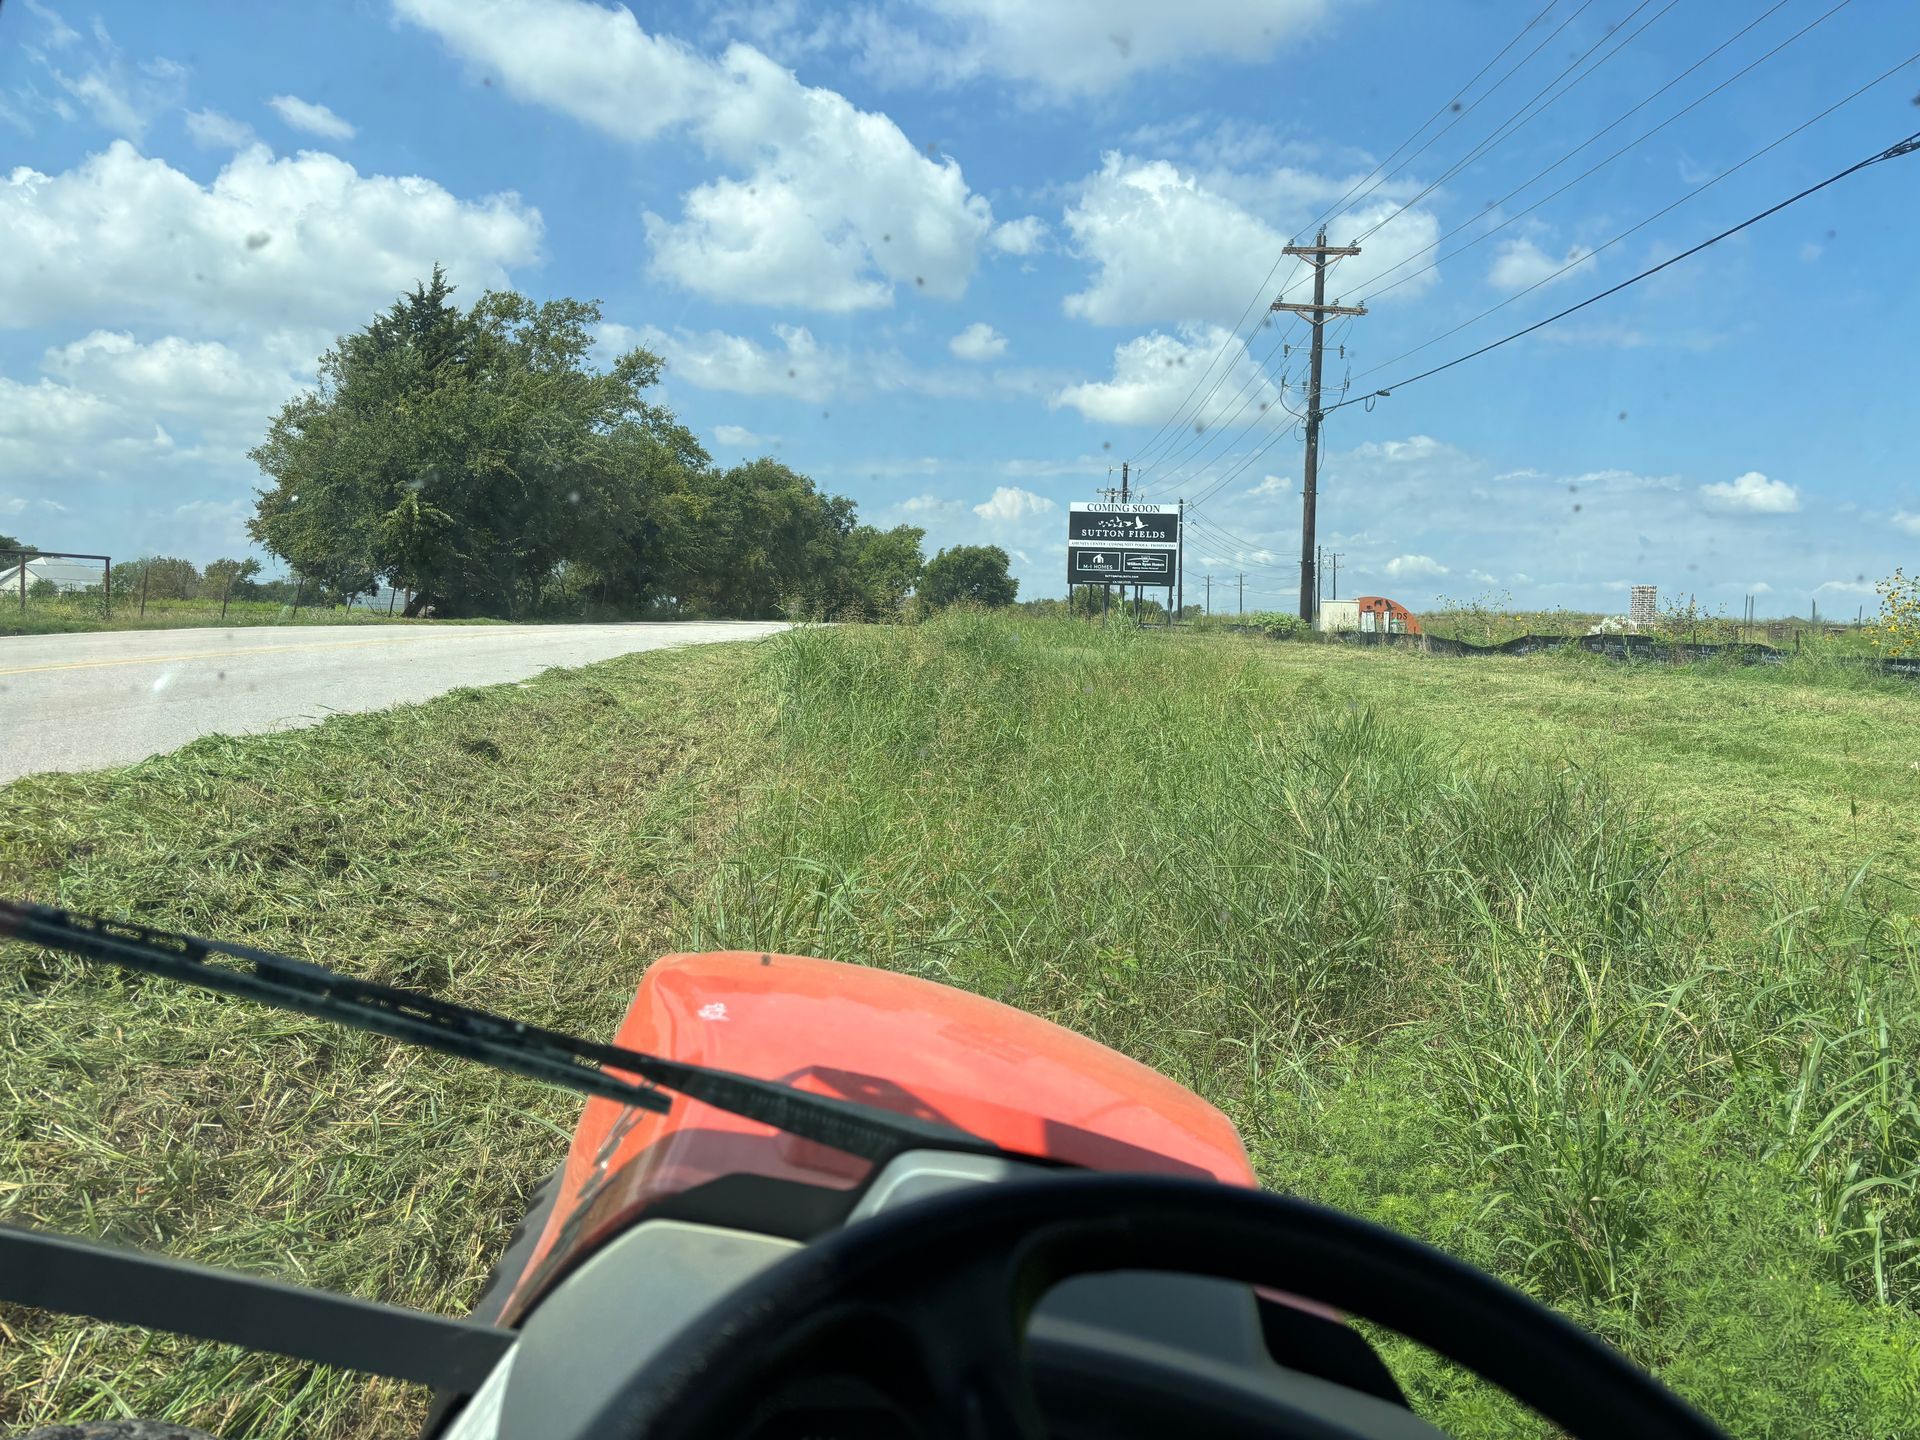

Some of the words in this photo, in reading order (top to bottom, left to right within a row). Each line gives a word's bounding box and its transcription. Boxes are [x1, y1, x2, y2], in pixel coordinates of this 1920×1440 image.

[1087, 503, 1129, 513] COMING
[1132, 504, 1160, 513] SOON
[1081, 529, 1125, 538] SUTTON
[1129, 530, 1166, 539] FIELDS
